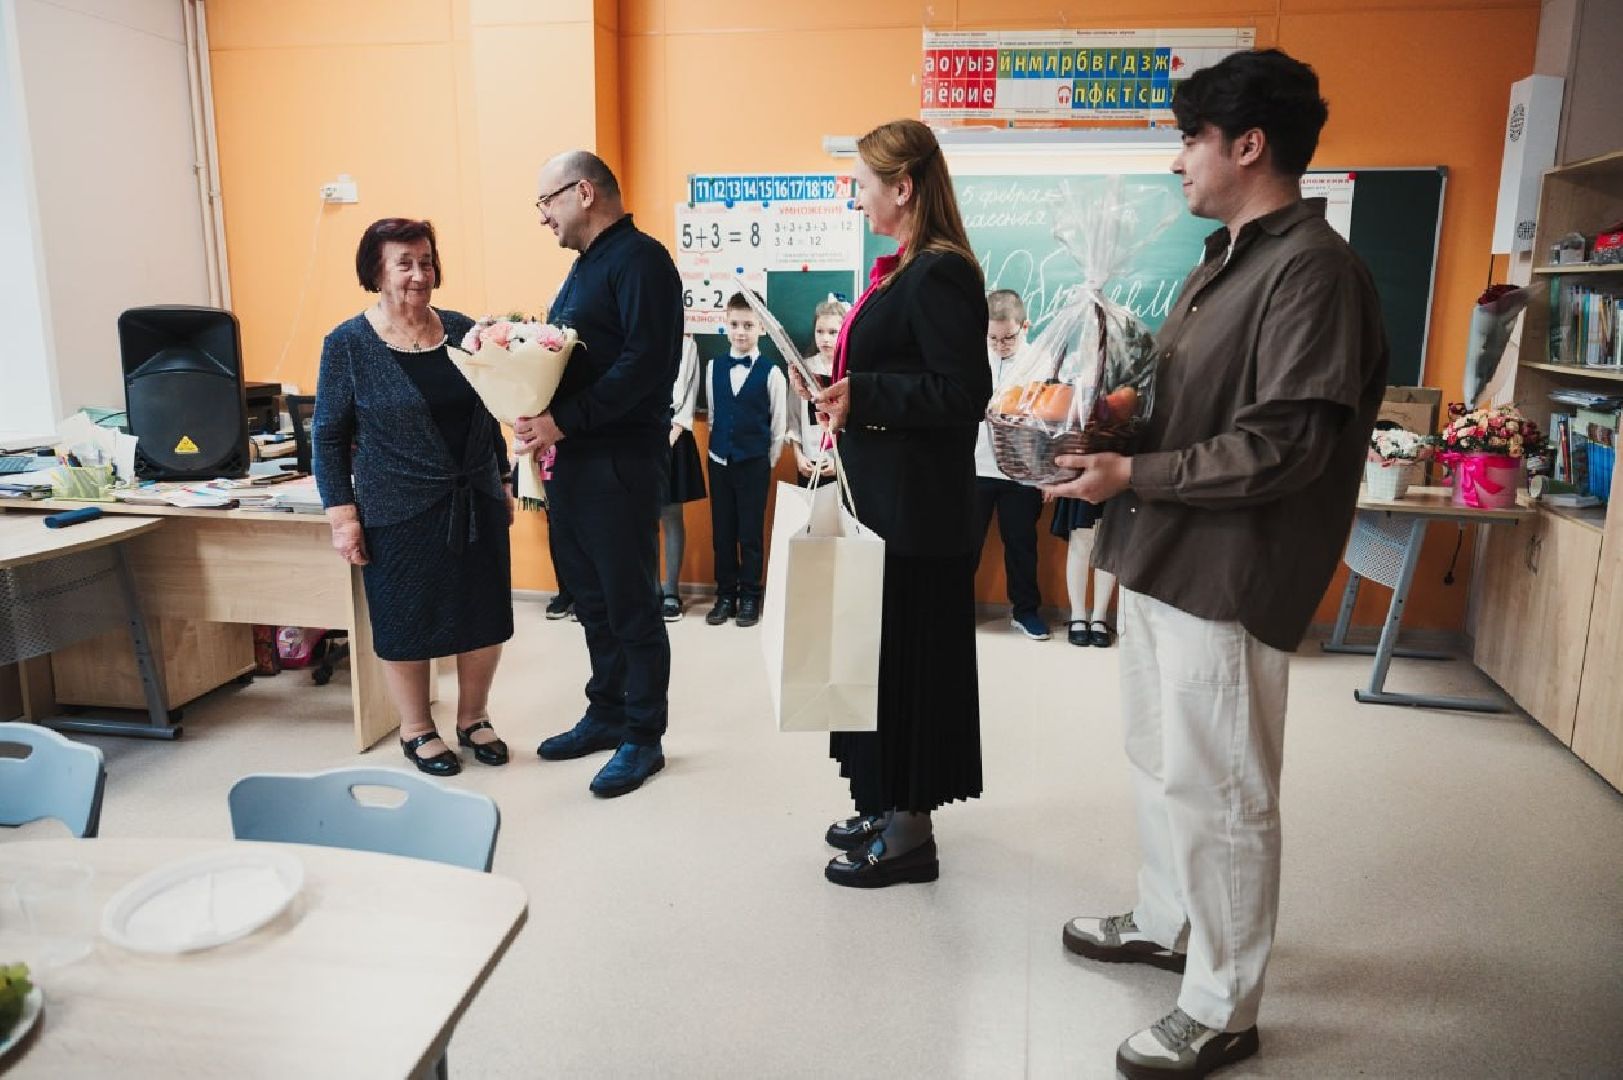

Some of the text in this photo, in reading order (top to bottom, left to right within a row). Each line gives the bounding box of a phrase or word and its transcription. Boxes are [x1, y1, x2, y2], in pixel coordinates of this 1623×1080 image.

[697, 181, 710, 198] 11
[713, 181, 725, 198] 12
[727, 181, 741, 198] 13
[743, 181, 757, 198] 14
[759, 181, 772, 198] 15
[774, 180, 787, 198] 16
[790, 180, 803, 197] 17
[805, 180, 819, 197] 18
[821, 180, 834, 197] 19
[751, 222, 760, 247] 8
[683, 289, 693, 308] 6
[713, 290, 724, 308] 2
